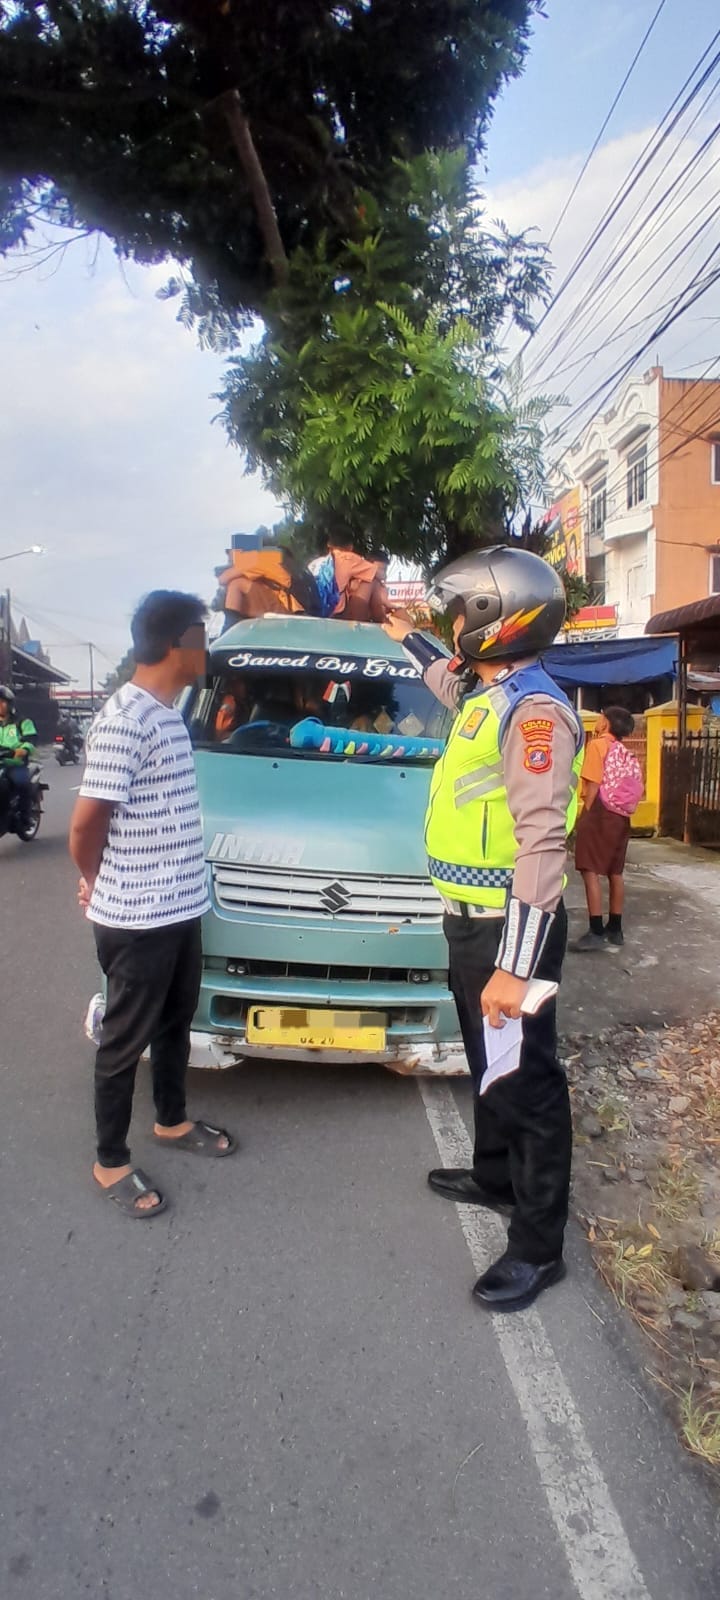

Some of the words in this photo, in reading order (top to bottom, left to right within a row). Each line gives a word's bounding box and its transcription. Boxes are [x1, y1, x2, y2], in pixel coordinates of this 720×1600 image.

[228, 653, 308, 668] Saved
[315, 656, 358, 674] By
[363, 659, 422, 679] Gra
